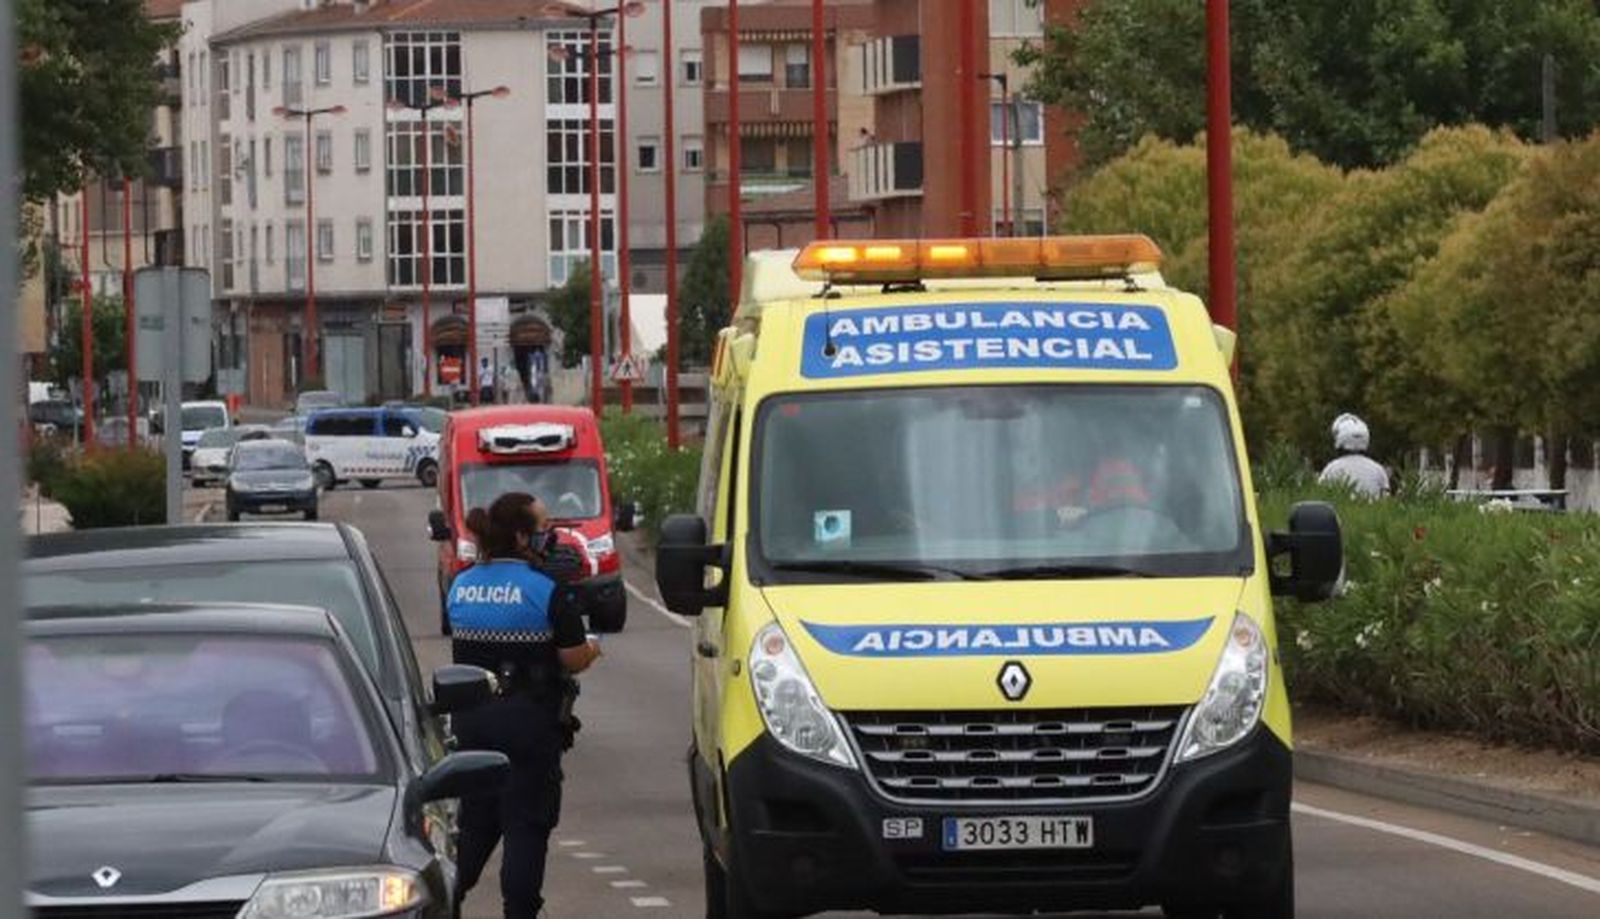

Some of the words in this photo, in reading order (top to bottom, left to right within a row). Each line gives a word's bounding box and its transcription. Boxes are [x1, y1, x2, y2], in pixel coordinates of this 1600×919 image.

[829, 310, 1152, 337] AMBULANCIA
[831, 337, 1153, 368] ASISTENCIAL
[455, 581, 522, 605] POLICÍA
[885, 819, 920, 837] SP
[963, 820, 1029, 845] 3033
[1040, 820, 1089, 845] HTW
